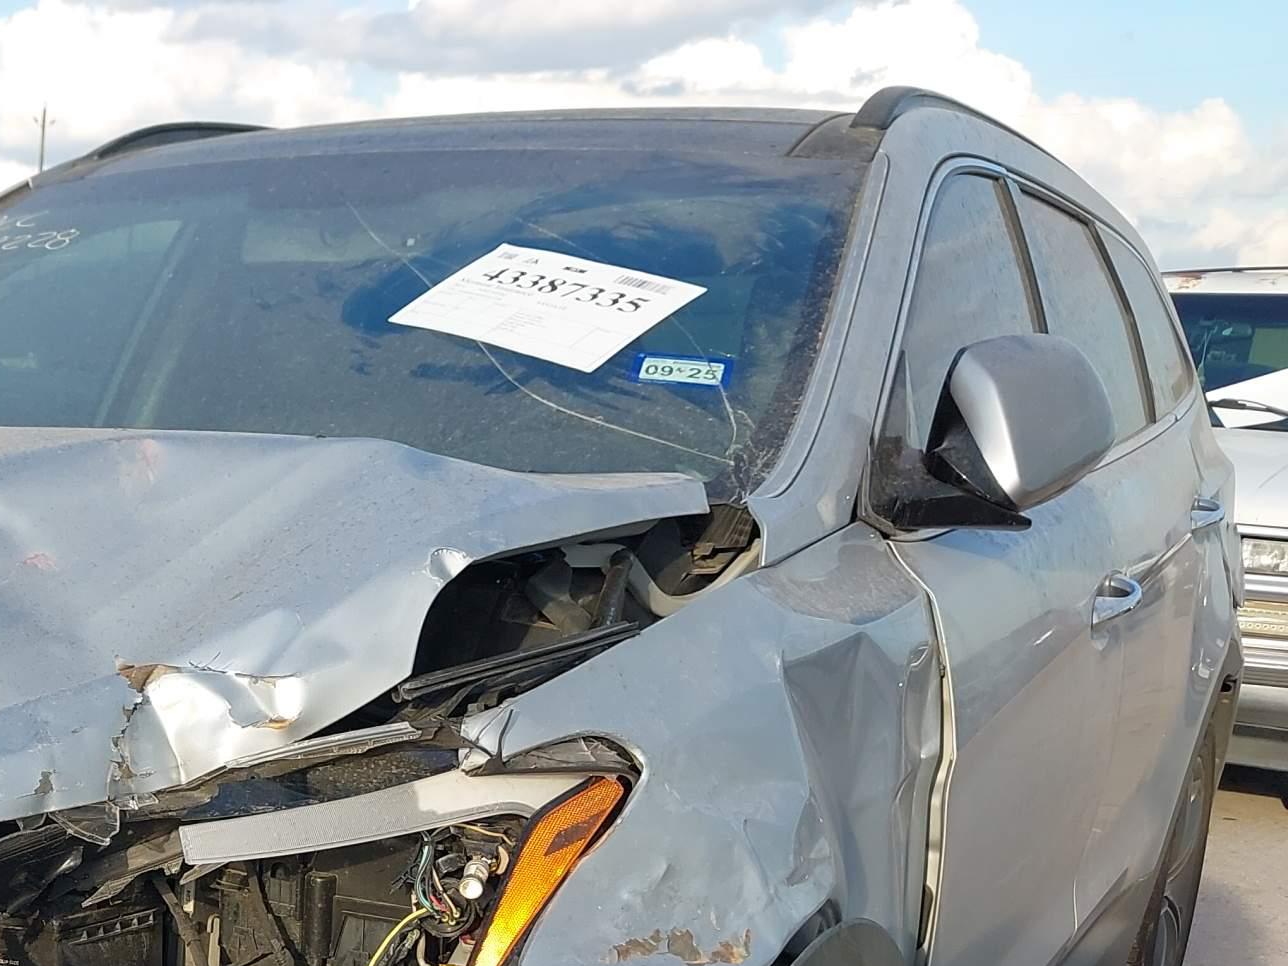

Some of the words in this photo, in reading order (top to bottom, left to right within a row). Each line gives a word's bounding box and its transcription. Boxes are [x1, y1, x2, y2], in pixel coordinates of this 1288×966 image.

[482, 268, 651, 313] 43387335
[644, 364, 674, 377] 09
[687, 367, 718, 380] 25
